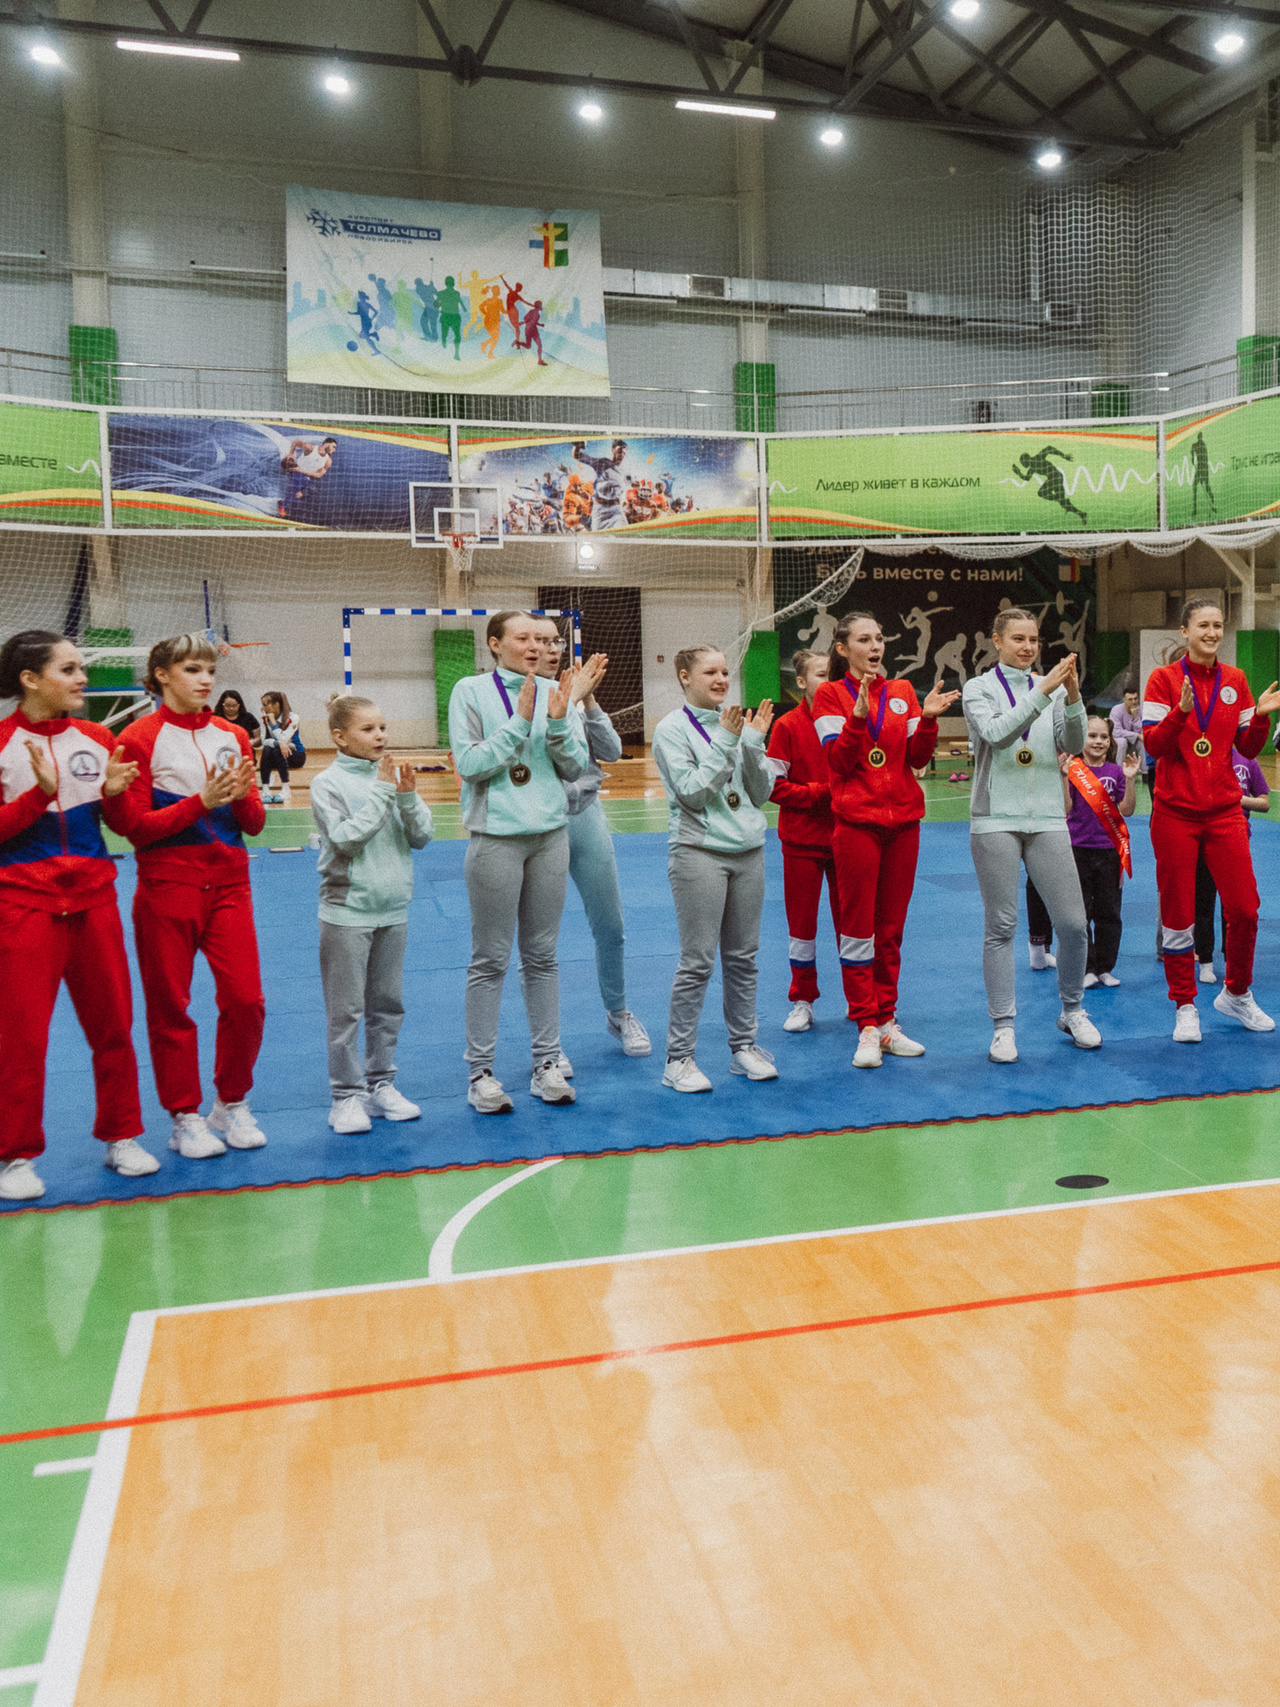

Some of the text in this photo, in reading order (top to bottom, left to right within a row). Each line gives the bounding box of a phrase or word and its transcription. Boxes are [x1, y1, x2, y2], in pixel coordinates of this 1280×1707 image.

[347, 222, 439, 239] ТОЛМАЧЕВО
[815, 476, 981, 493] Лидер живет в каждом
[873, 567, 945, 581] вместе
[950, 568, 962, 581] с
[967, 566, 1024, 581] нами!
